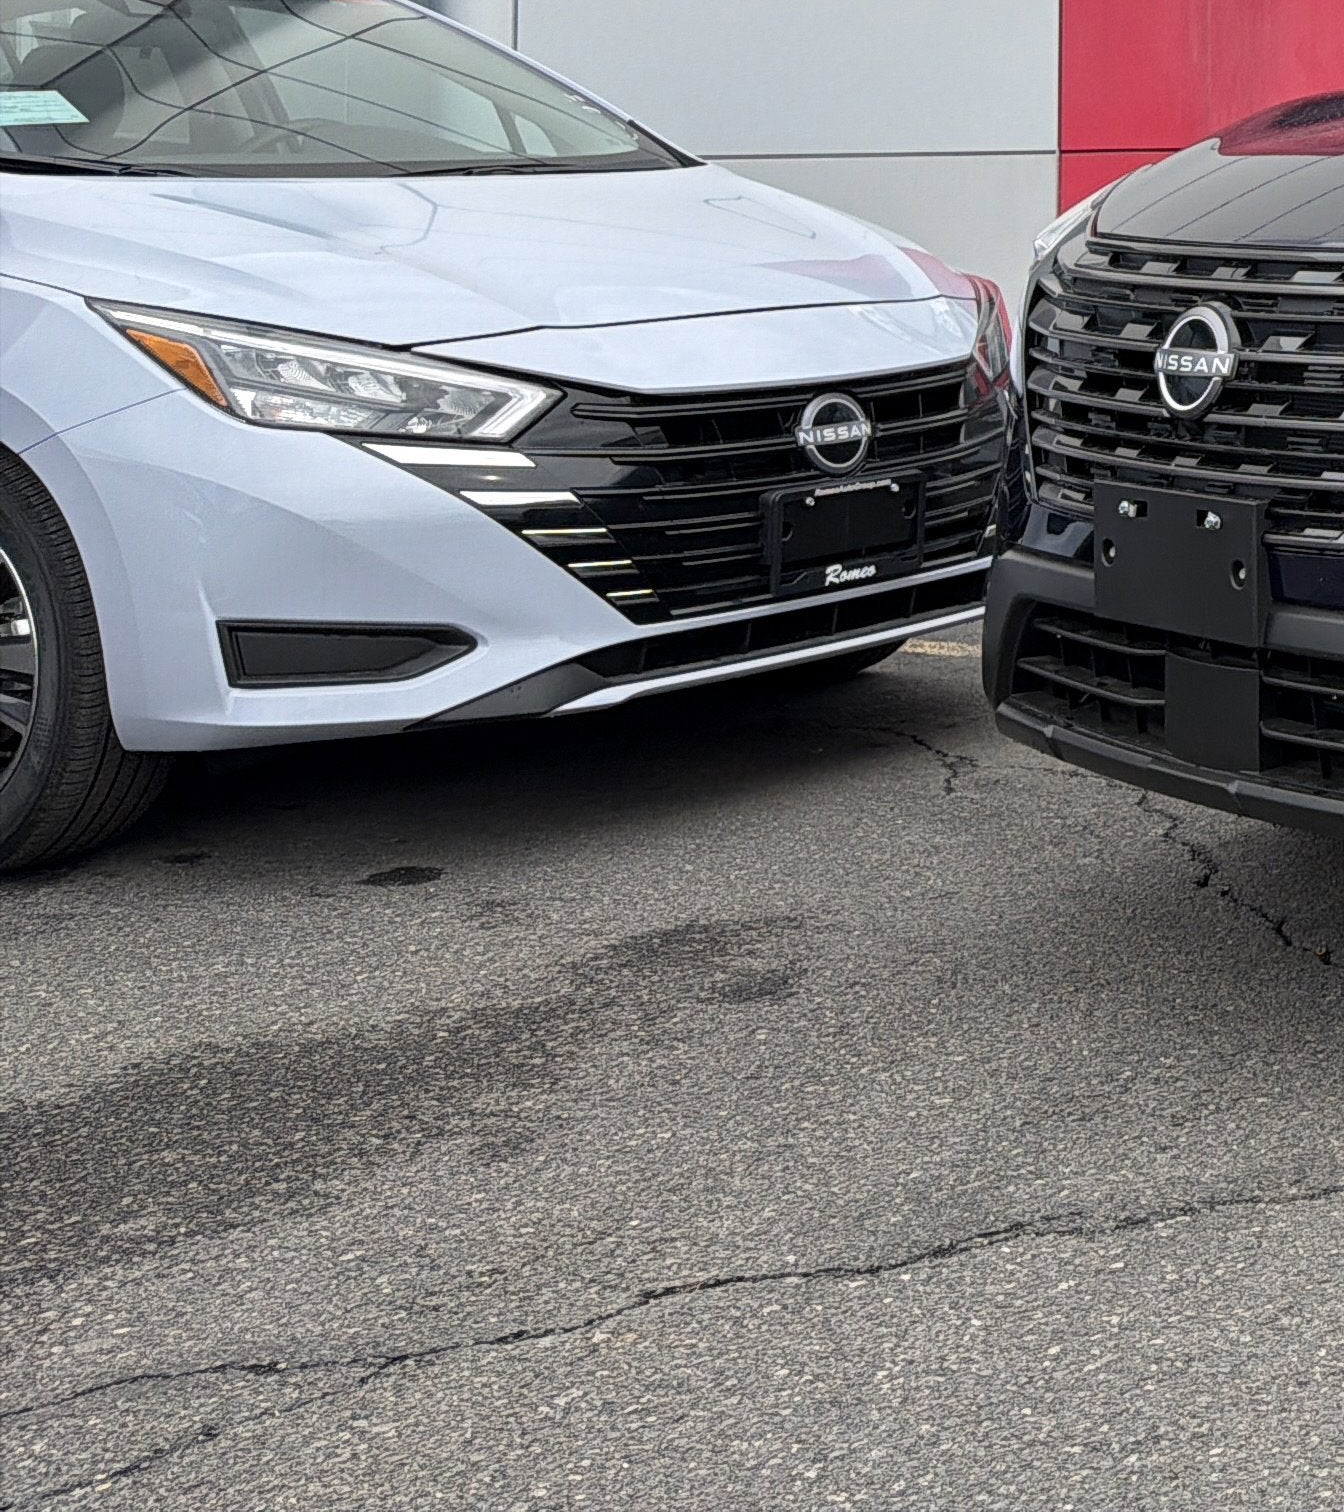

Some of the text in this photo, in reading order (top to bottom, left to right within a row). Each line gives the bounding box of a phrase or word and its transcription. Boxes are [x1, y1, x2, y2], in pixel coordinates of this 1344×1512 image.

[1156, 351, 1230, 374] NISSAN
[798, 420, 872, 444] NISSAN
[824, 564, 877, 587] Romeo
